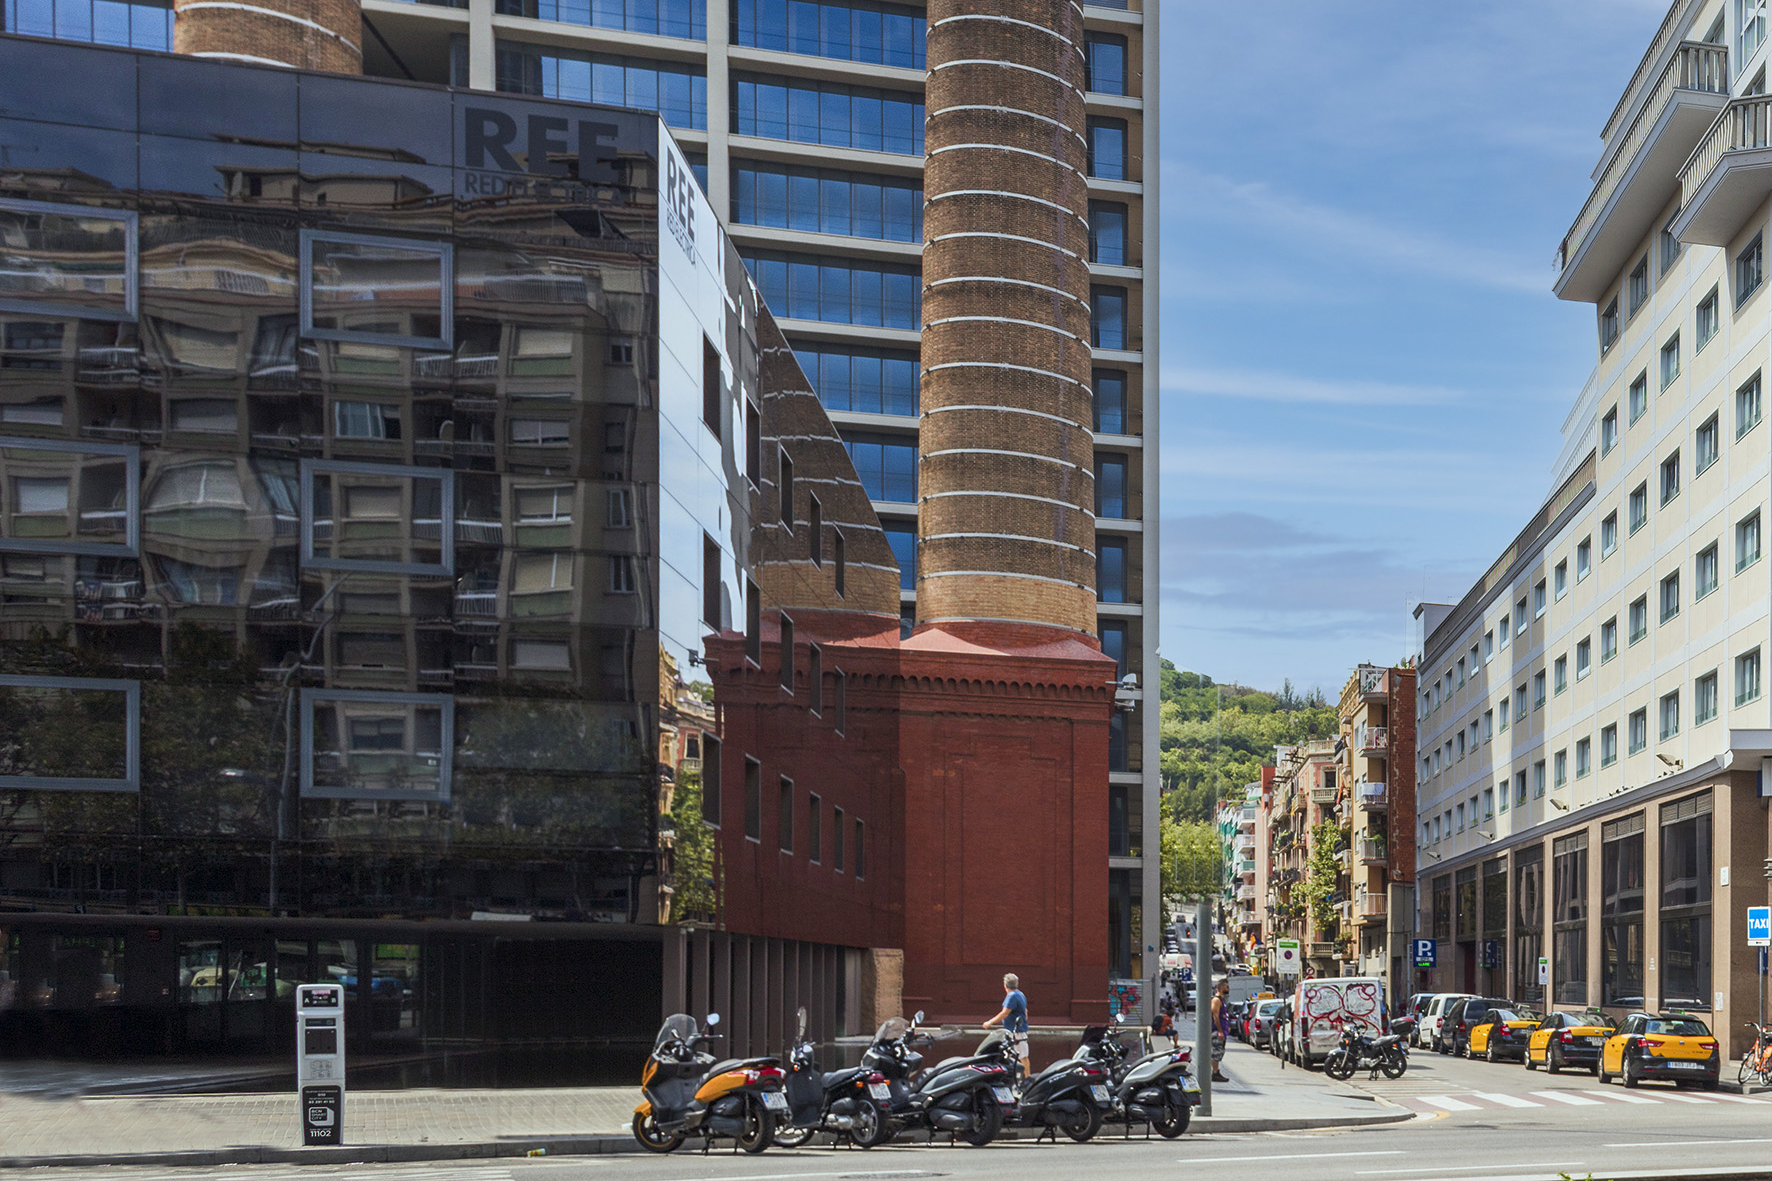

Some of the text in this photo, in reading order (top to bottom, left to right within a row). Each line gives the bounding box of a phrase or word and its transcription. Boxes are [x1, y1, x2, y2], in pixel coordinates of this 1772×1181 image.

[465, 107, 623, 185] REE
[465, 172, 506, 196] RED
[667, 144, 695, 244] REE
[1749, 919, 1769, 929] TAXI
[1418, 940, 1432, 956] P
